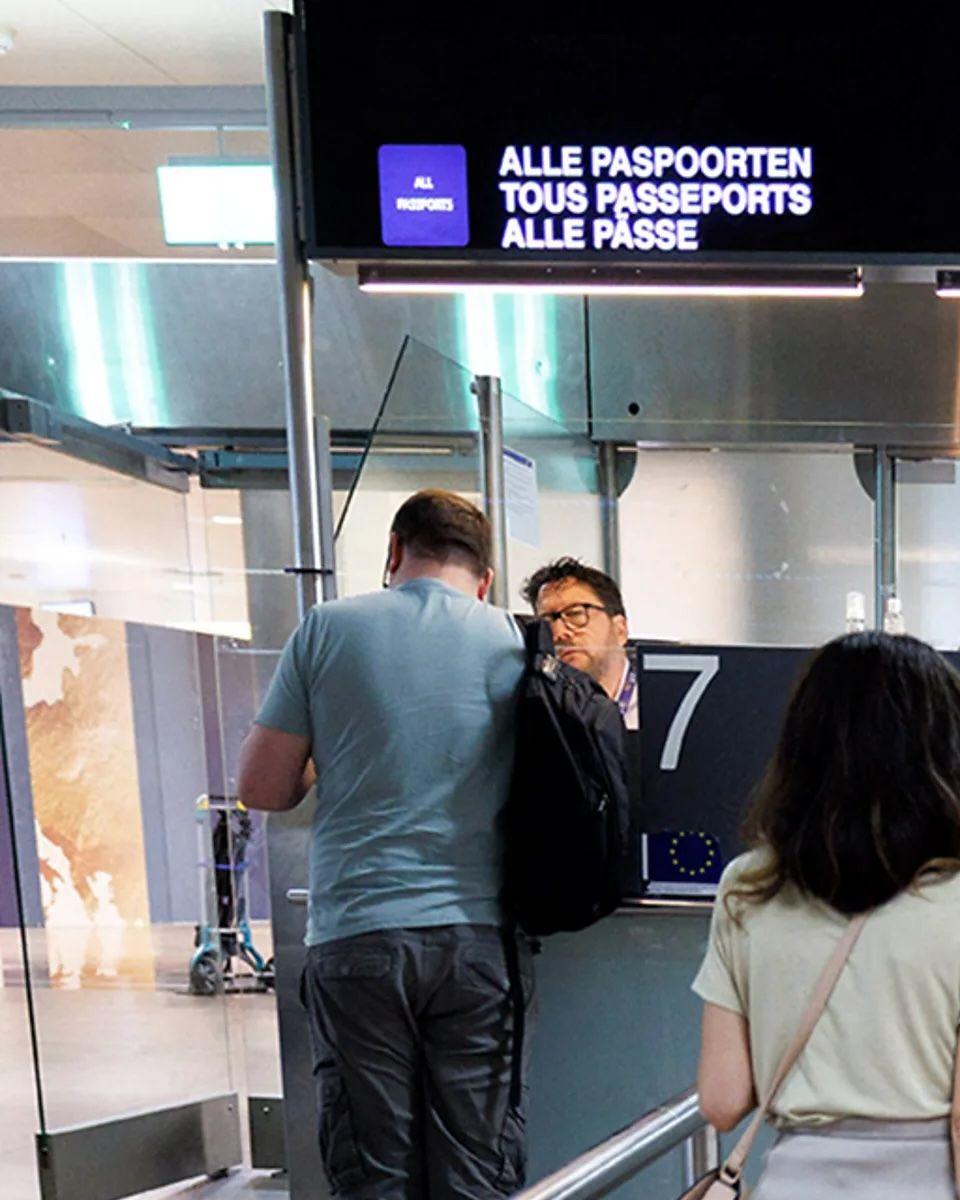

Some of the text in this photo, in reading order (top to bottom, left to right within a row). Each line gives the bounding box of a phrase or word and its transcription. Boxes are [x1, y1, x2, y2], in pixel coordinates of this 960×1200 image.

[500, 146, 812, 178] ALLE PASPOORTEN
[414, 176, 434, 189] ALL
[499, 182, 812, 216] TOUS PASSEPORTS
[502, 219, 586, 249] ALLE
[643, 655, 721, 771] 7
